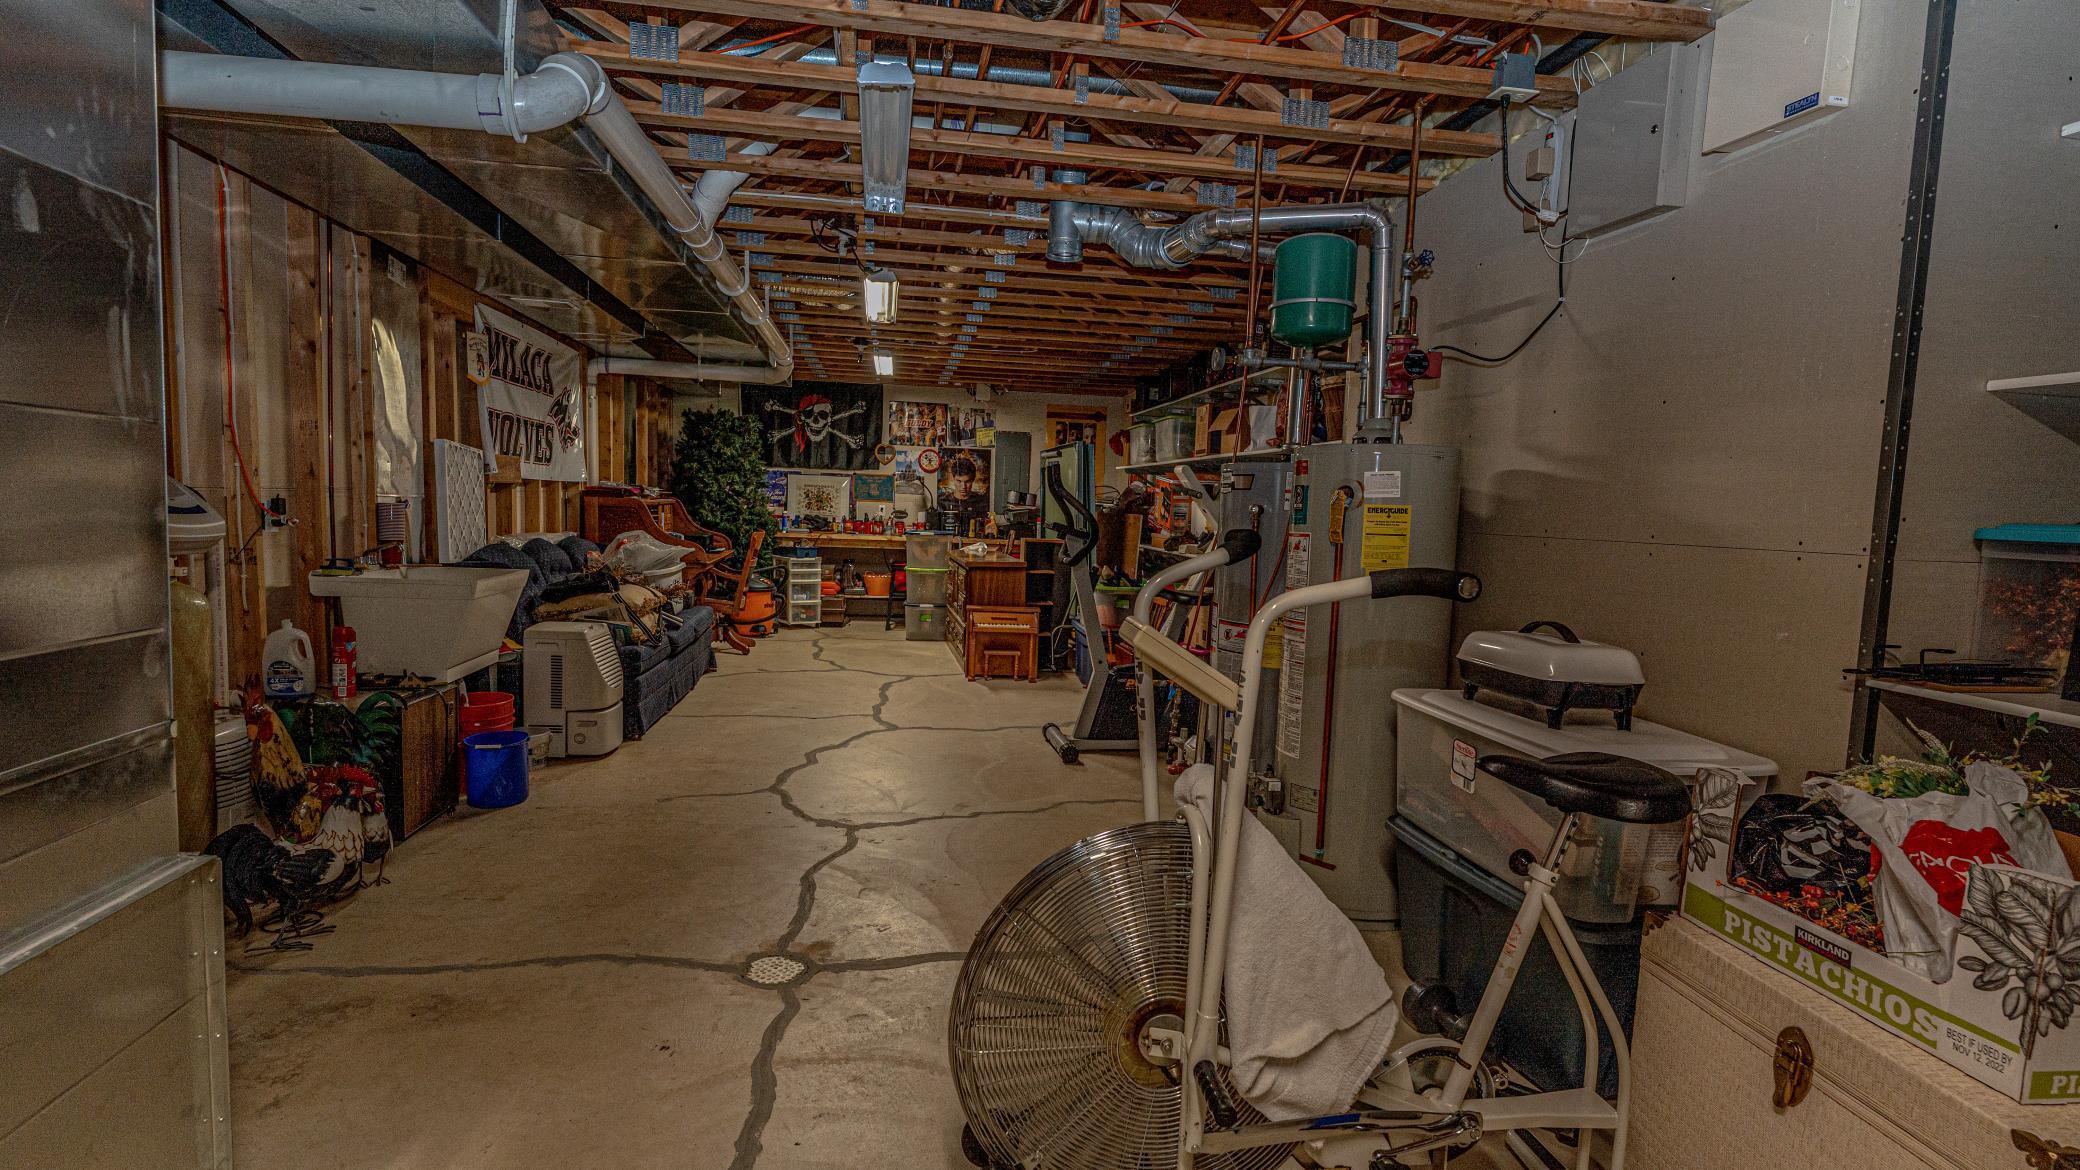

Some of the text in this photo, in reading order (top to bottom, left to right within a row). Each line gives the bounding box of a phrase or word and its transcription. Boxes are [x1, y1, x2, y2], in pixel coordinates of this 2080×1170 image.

[1796, 927, 1850, 962] KIRKLAND
[1723, 908, 1940, 1044] PISTACHIOS
[1946, 1027, 2013, 1066] BEST IF USED BY
[1952, 1042, 1971, 1057] NOV
[1985, 1058, 2006, 1074] 2022
